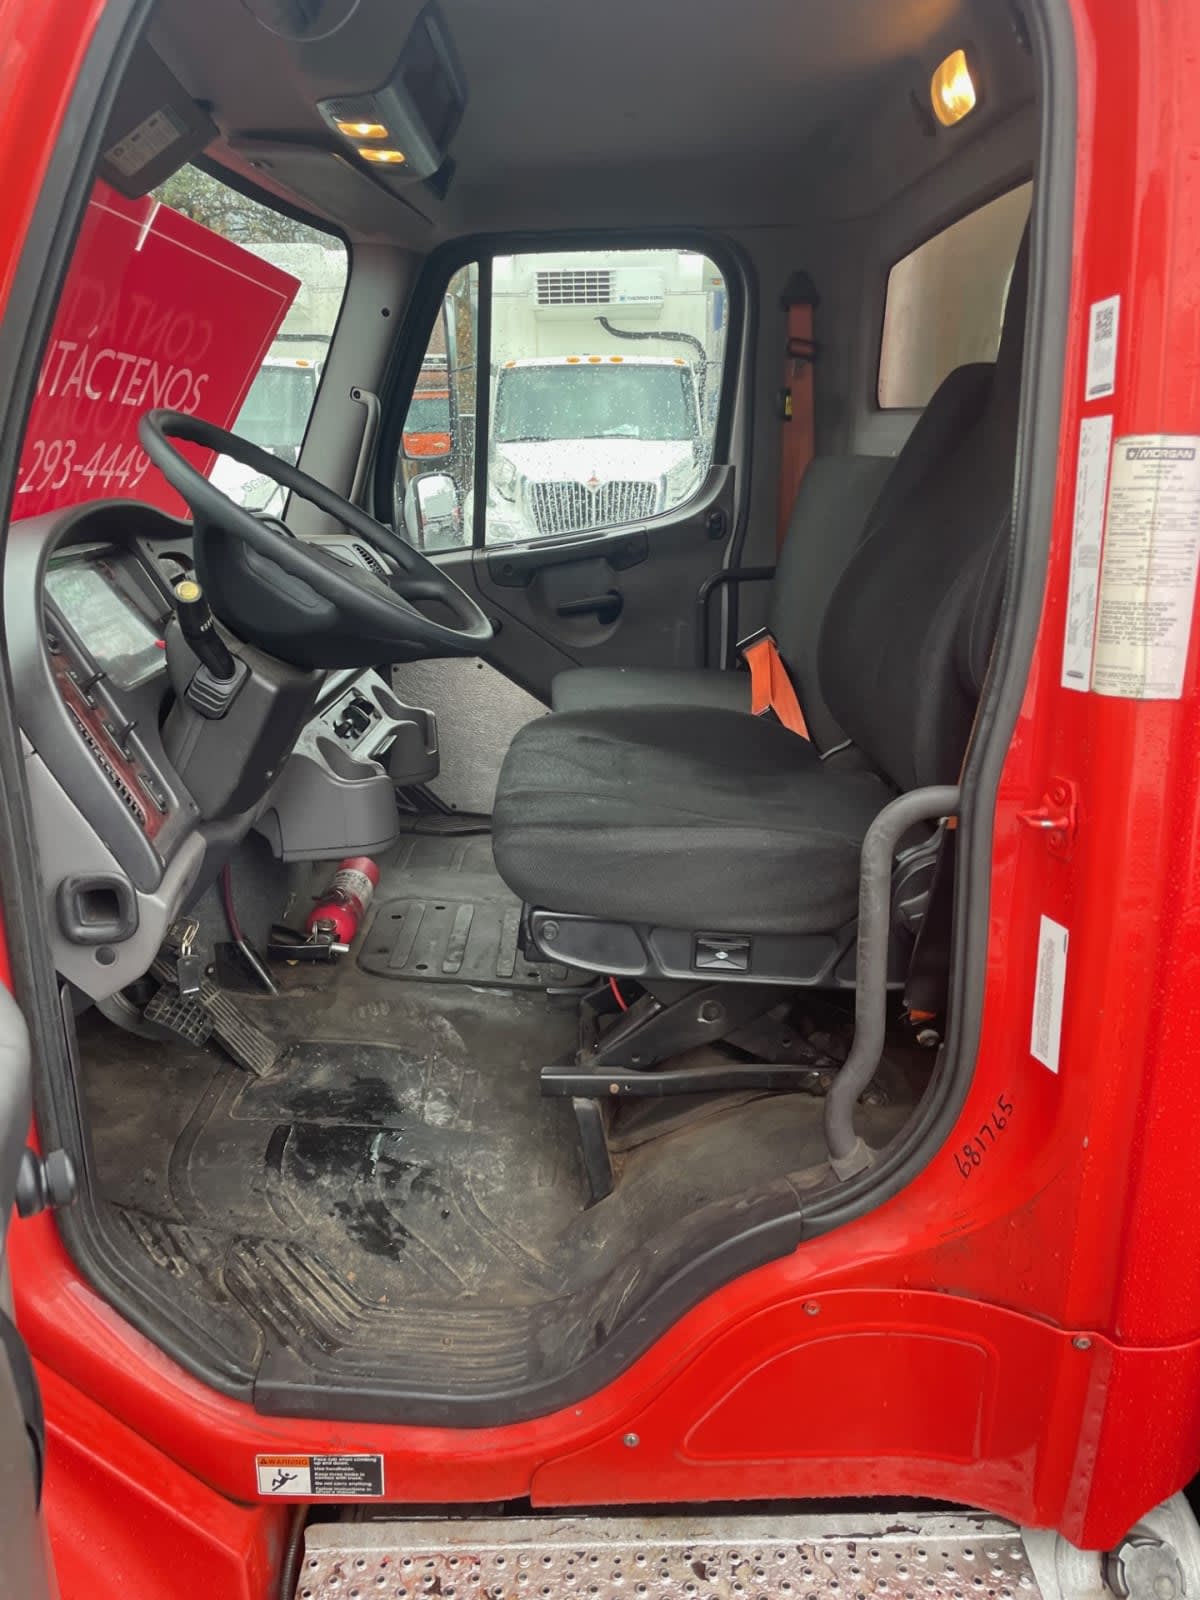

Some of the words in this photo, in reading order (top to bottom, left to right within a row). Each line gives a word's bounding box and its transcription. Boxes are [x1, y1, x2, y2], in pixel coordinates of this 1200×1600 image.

[1139, 448, 1193, 459] MORGAN
[953, 1094, 1013, 1179] 681765
[268, 1458, 308, 1466] WARNING
